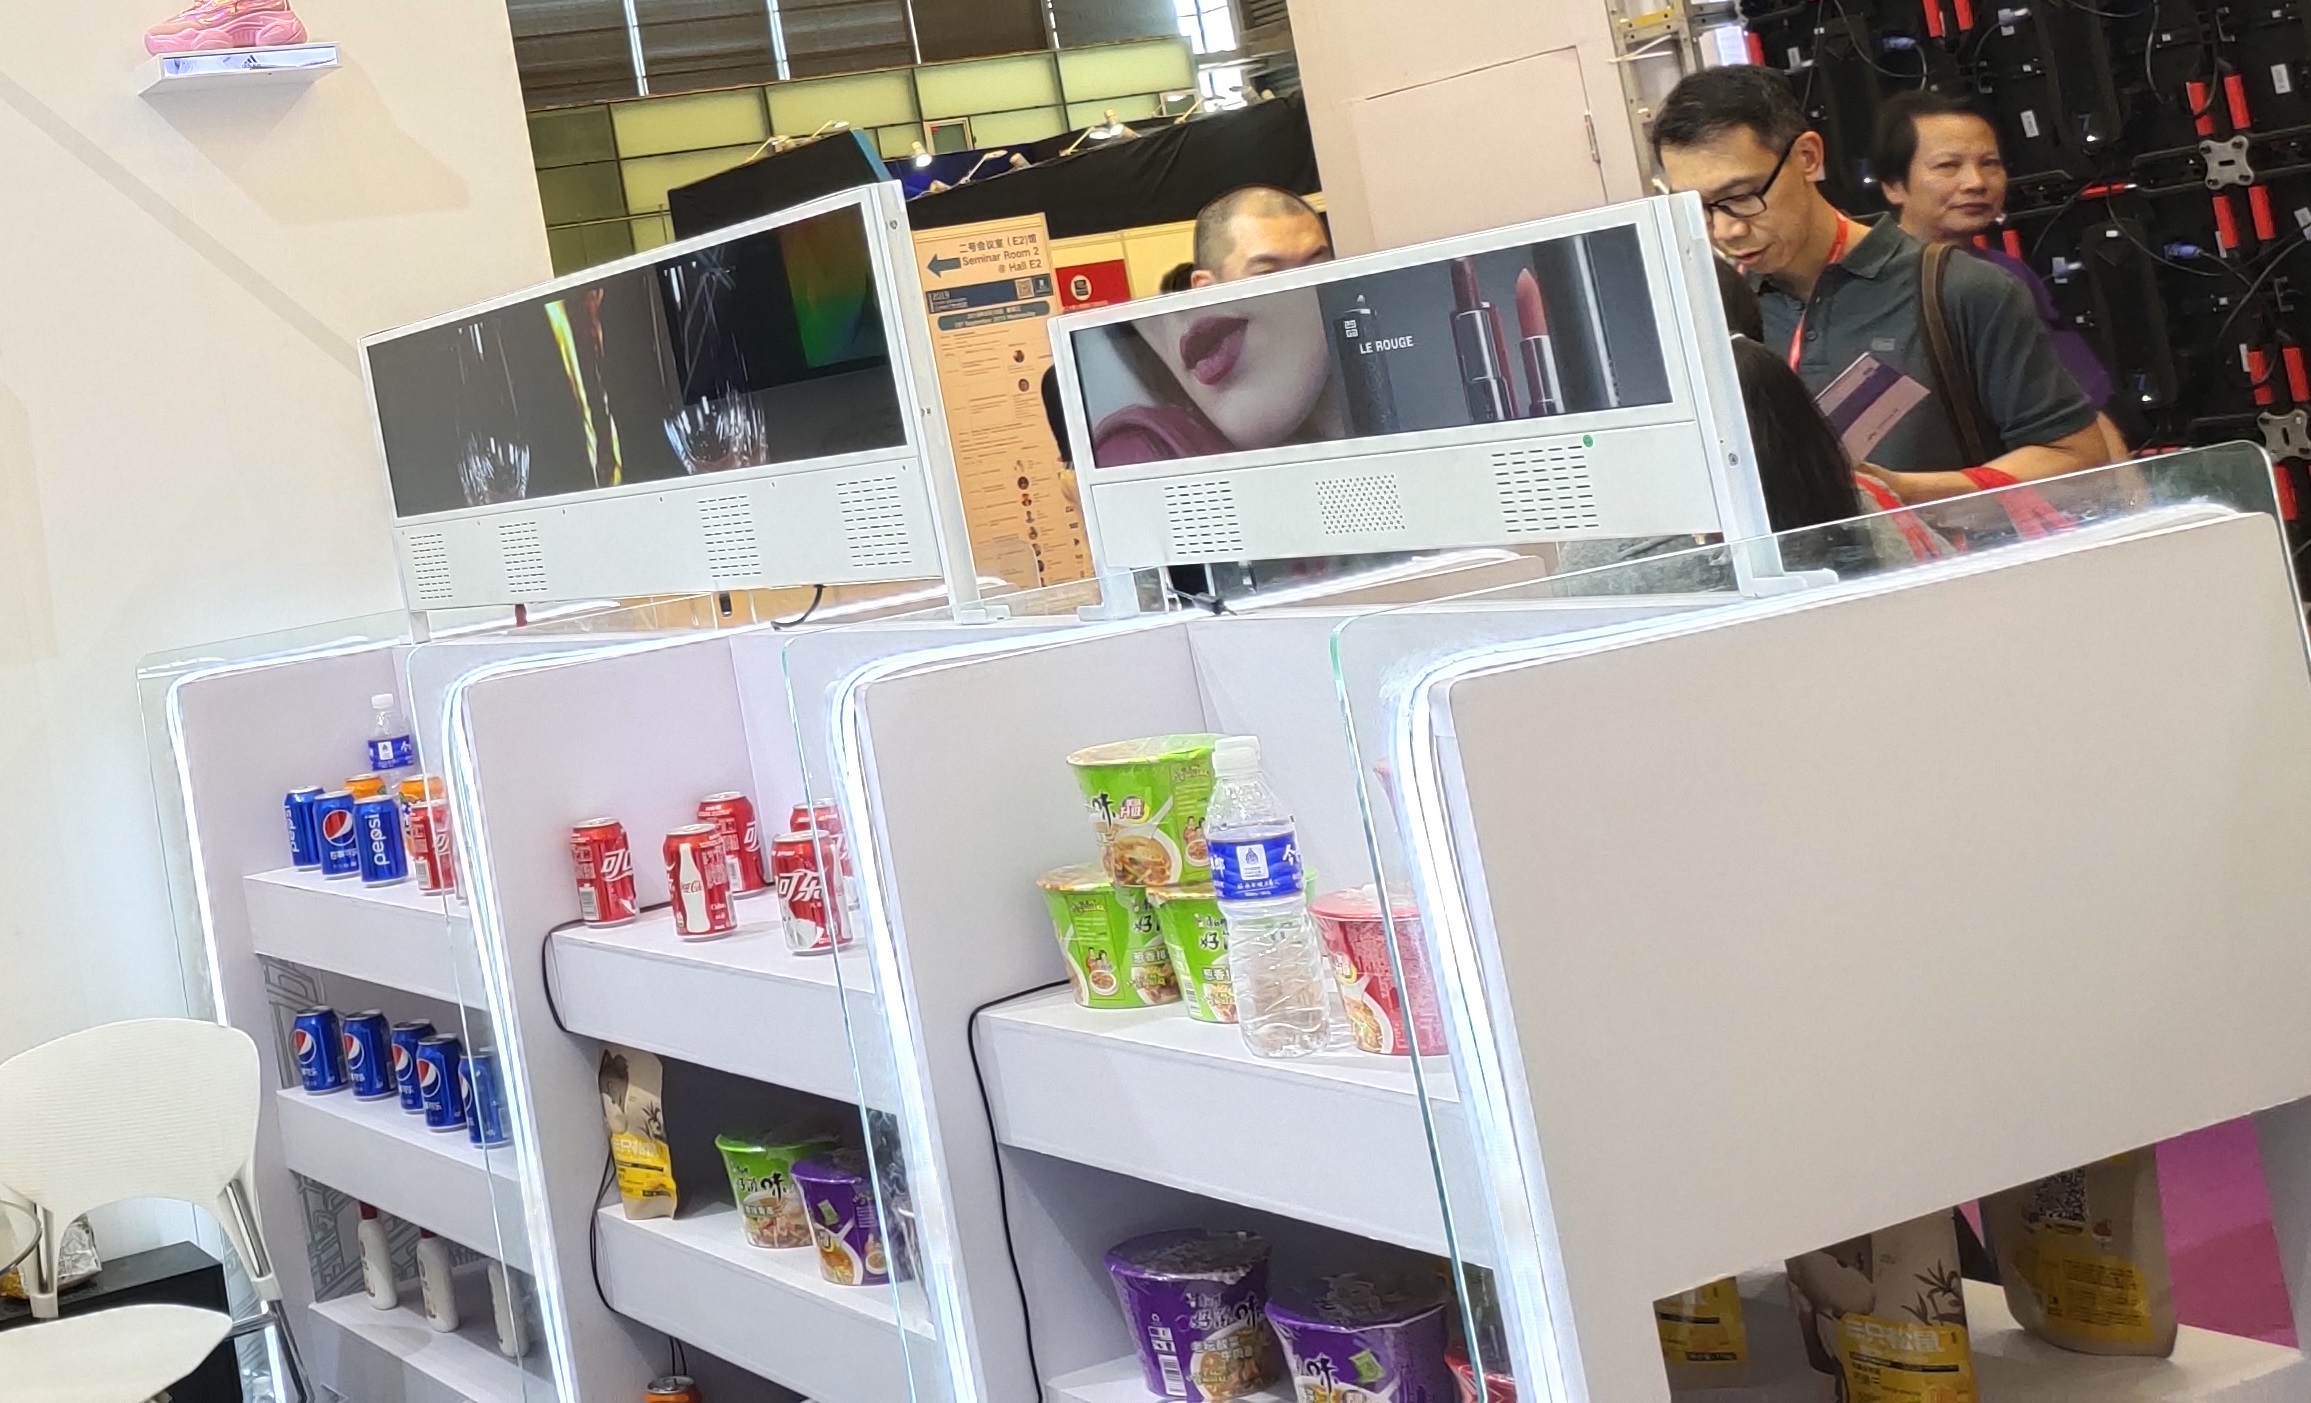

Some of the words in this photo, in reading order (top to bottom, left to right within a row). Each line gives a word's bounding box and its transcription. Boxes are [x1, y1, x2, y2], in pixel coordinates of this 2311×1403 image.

[963, 252, 1001, 267] Seminar
[1003, 248, 1031, 260] Room
[1033, 246, 1040, 256] 2
[1008, 260, 1027, 272] Hall
[1029, 258, 1043, 269] E2
[1359, 341, 1374, 355] LE
[1375, 335, 1415, 353] ROUGE
[363, 813, 391, 866] pepsi
[775, 868, 823, 903] 可乐
[1133, 913, 1160, 934] 好
